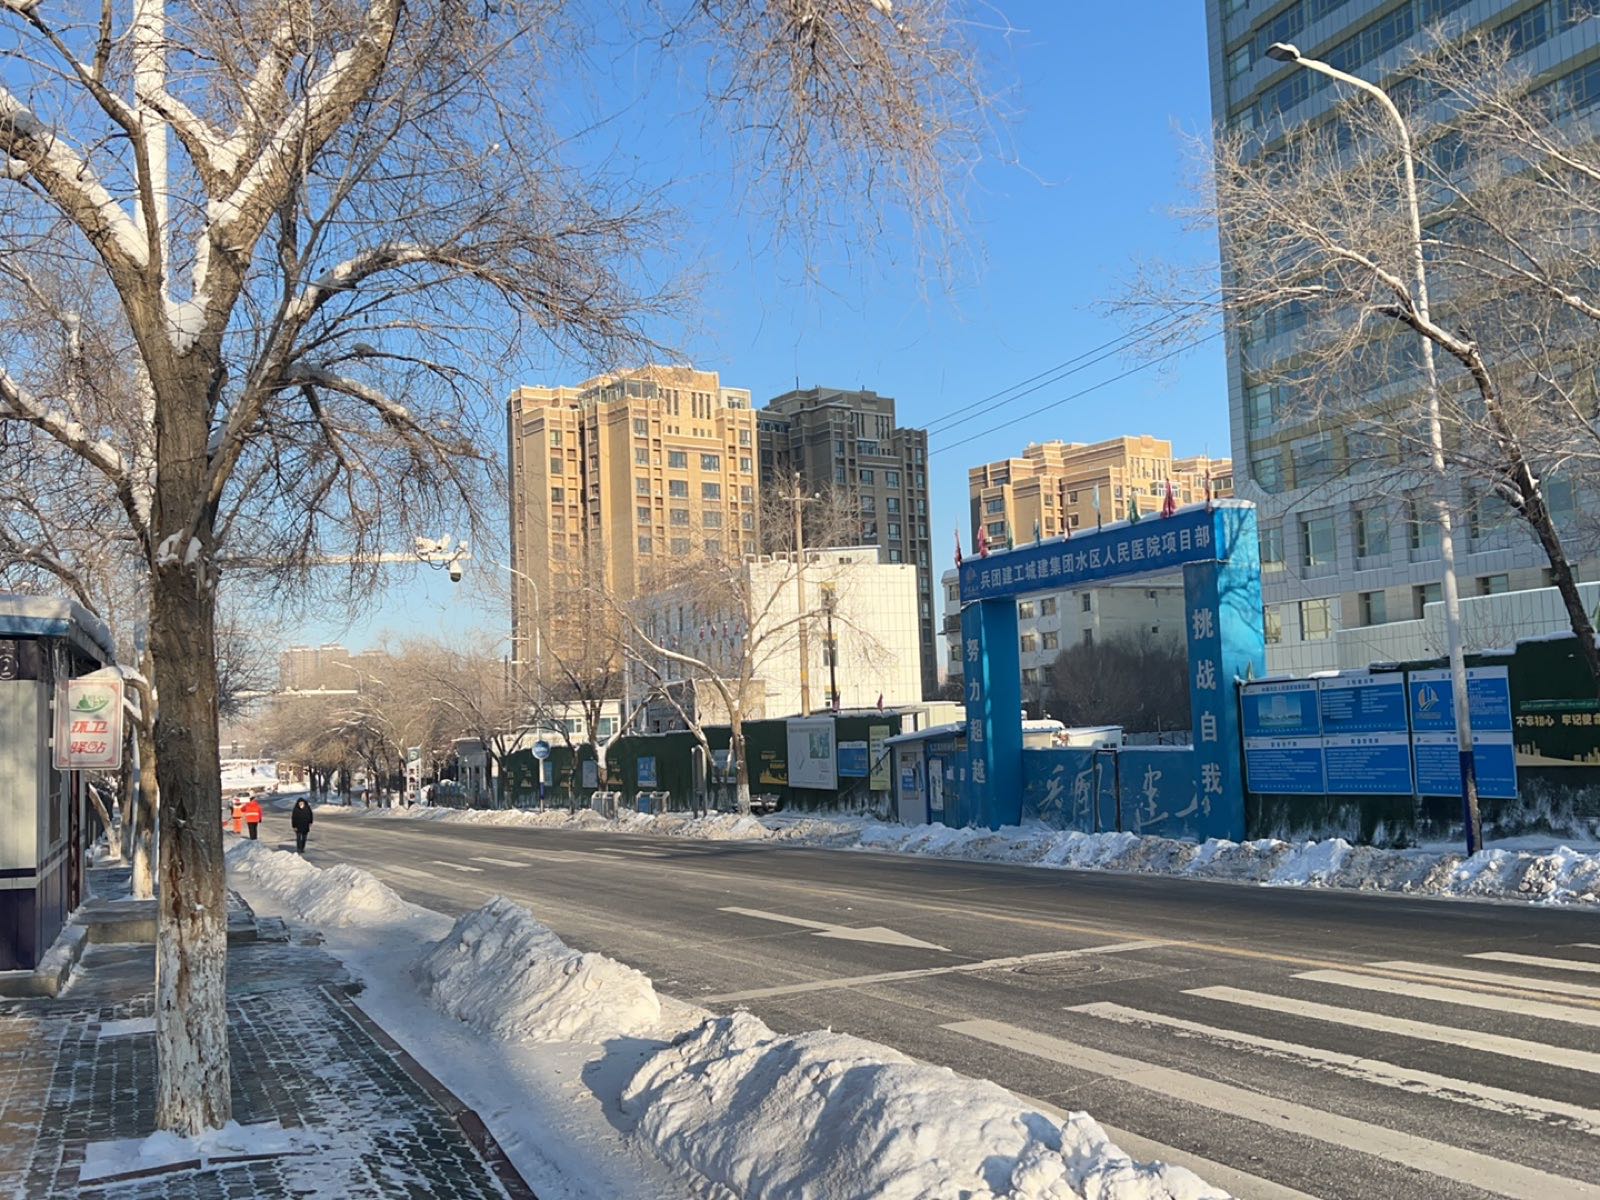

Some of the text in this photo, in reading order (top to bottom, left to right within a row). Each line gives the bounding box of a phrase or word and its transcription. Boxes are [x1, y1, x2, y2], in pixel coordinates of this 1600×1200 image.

[979, 524, 1211, 589] 兵团建工城建集团水区人民医院项目部
[966, 637, 986, 784] 努力超越
[1192, 608, 1222, 794] 挑战自我
[71, 720, 109, 734] 环卫
[1515, 715, 1555, 728] 不忘初心
[70, 740, 108, 754] 驿站
